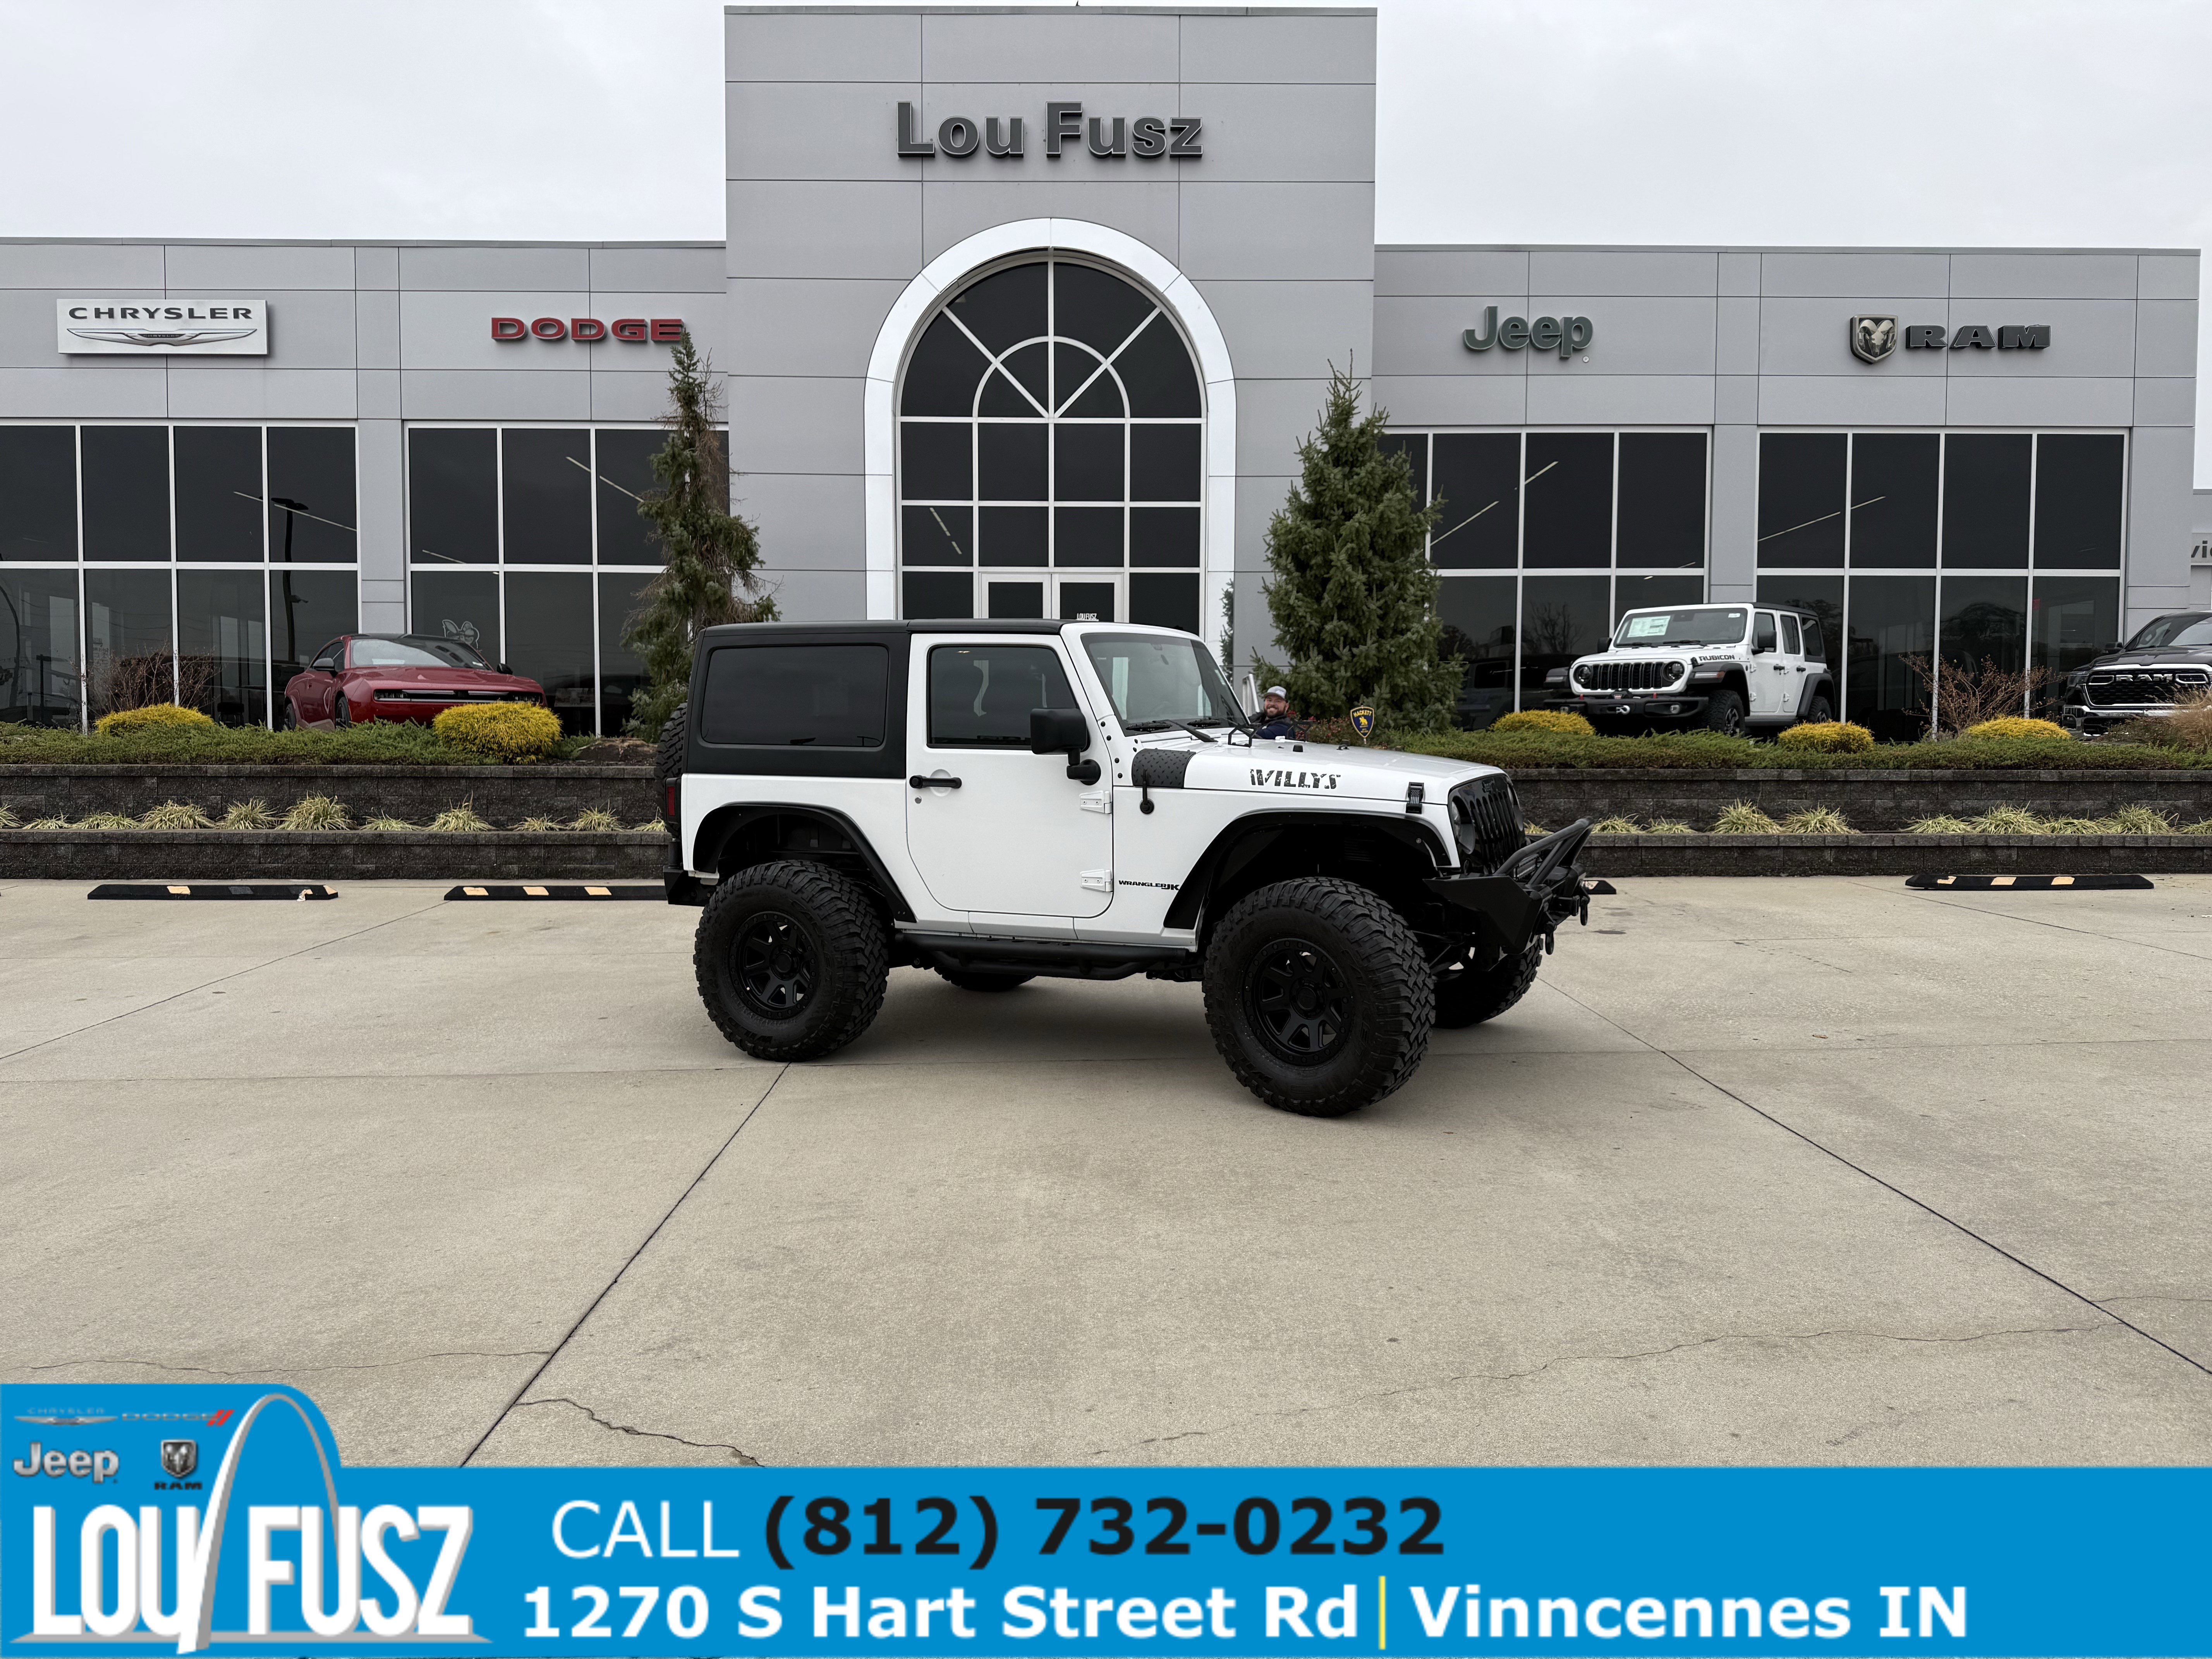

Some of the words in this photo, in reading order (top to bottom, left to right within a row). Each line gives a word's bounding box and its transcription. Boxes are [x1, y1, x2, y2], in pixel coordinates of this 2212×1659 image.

[896, 101, 1024, 157] Lou
[1045, 101, 1203, 158] Fusz
[69, 307, 253, 319] CHRYSLER
[491, 317, 684, 342] DODGE
[1462, 306, 1594, 359] Jeep
[1906, 324, 2051, 349] RAM
[2116, 673, 2173, 682] RAM
[1250, 768, 1341, 789] WILLYS
[1118, 880, 1167, 888] WRANGLER
